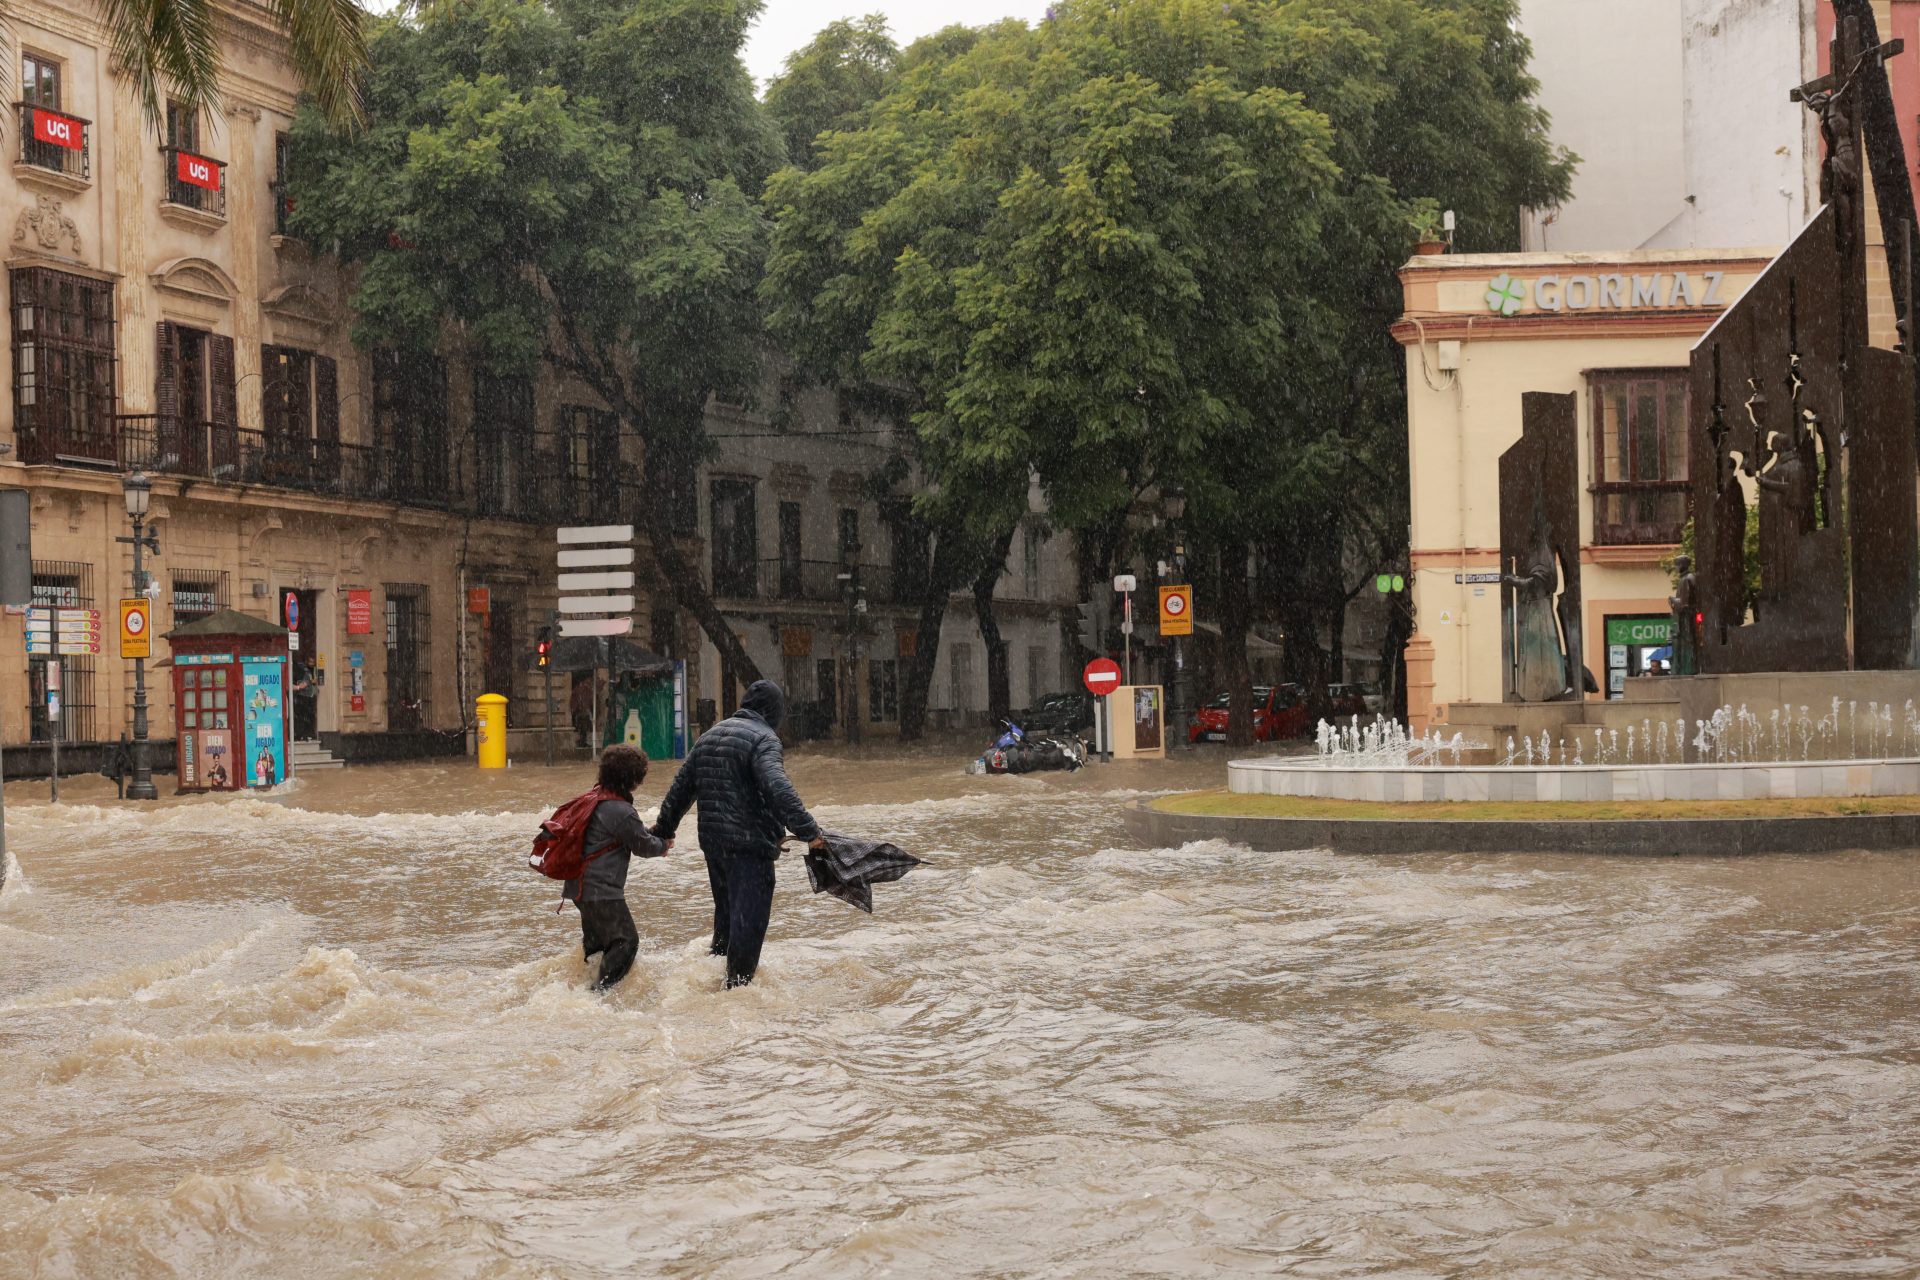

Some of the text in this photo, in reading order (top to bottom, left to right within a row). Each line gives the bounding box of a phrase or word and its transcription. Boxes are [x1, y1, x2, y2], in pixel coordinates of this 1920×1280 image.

[47, 119, 70, 140] UCI
[189, 162, 209, 182] UCI
[1534, 271, 1725, 312] GORMAZ
[259, 674, 280, 685] JUGADO
[256, 723, 272, 738] BIEN
[207, 735, 223, 746] BIEN
[255, 737, 275, 748] JUGADO
[205, 745, 227, 755] JUGADO
